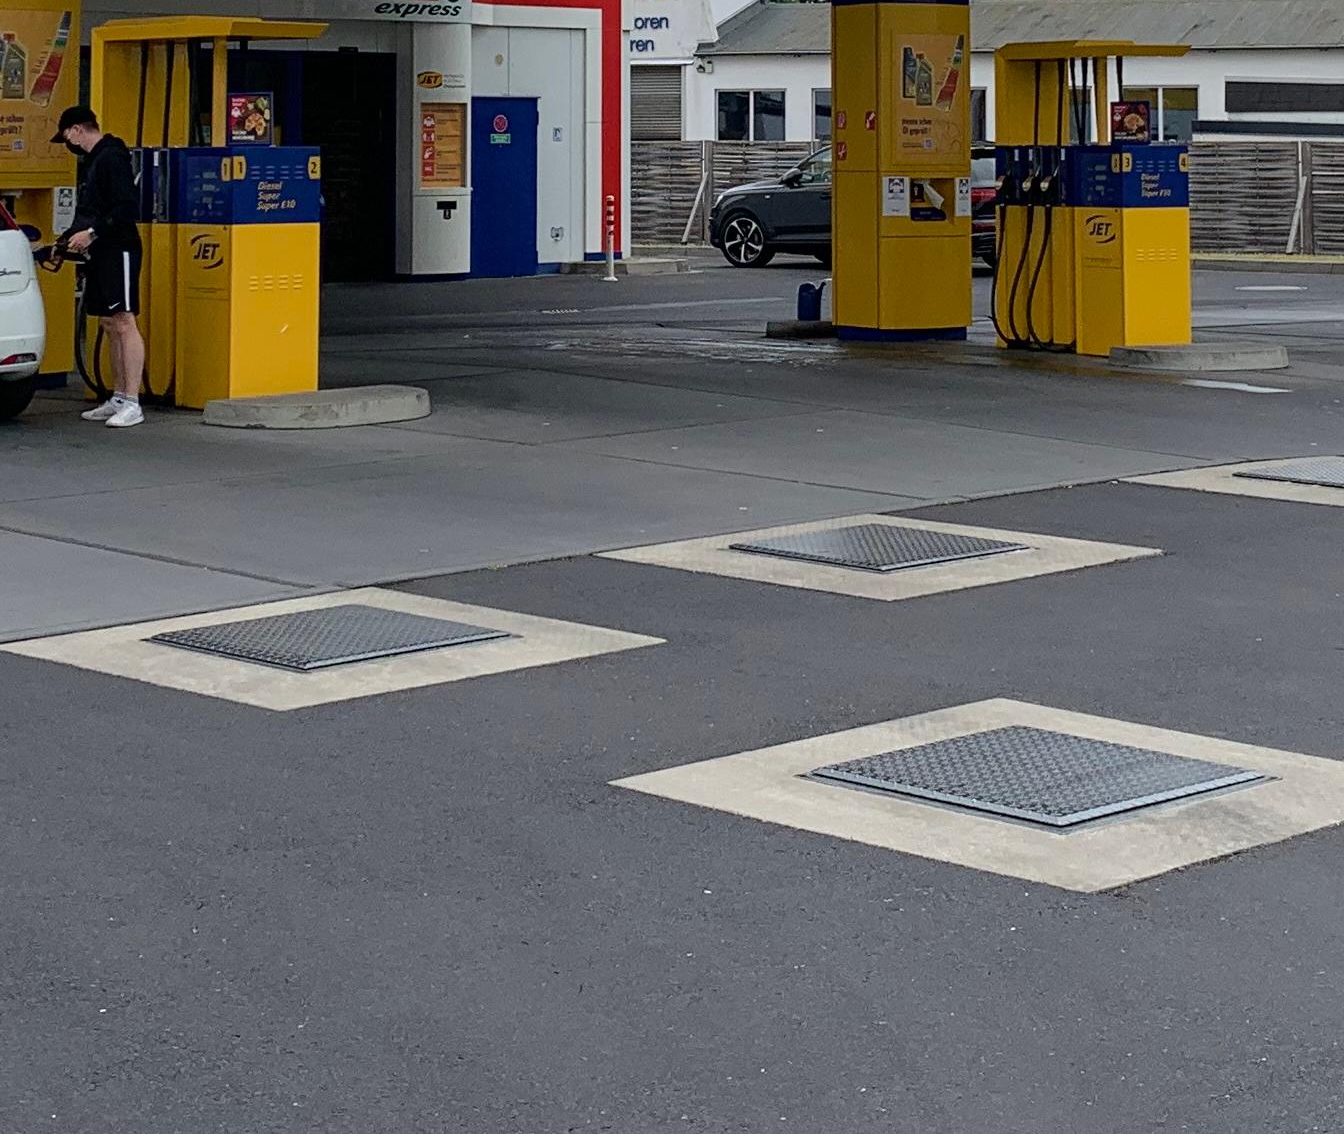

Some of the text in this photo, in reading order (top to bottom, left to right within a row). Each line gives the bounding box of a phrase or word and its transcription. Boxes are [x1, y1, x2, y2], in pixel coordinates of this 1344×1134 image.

[374, 2, 462, 18] express
[421, 75, 440, 85] JET
[237, 161, 243, 174] 1
[310, 161, 318, 174] 2
[1125, 157, 1131, 168] 3
[1180, 157, 1187, 168] 4
[257, 181, 283, 190] Diesel
[257, 191, 281, 202] Super
[256, 199, 296, 212] Super E10
[1089, 222, 1112, 236] JET
[193, 243, 220, 260] JET
